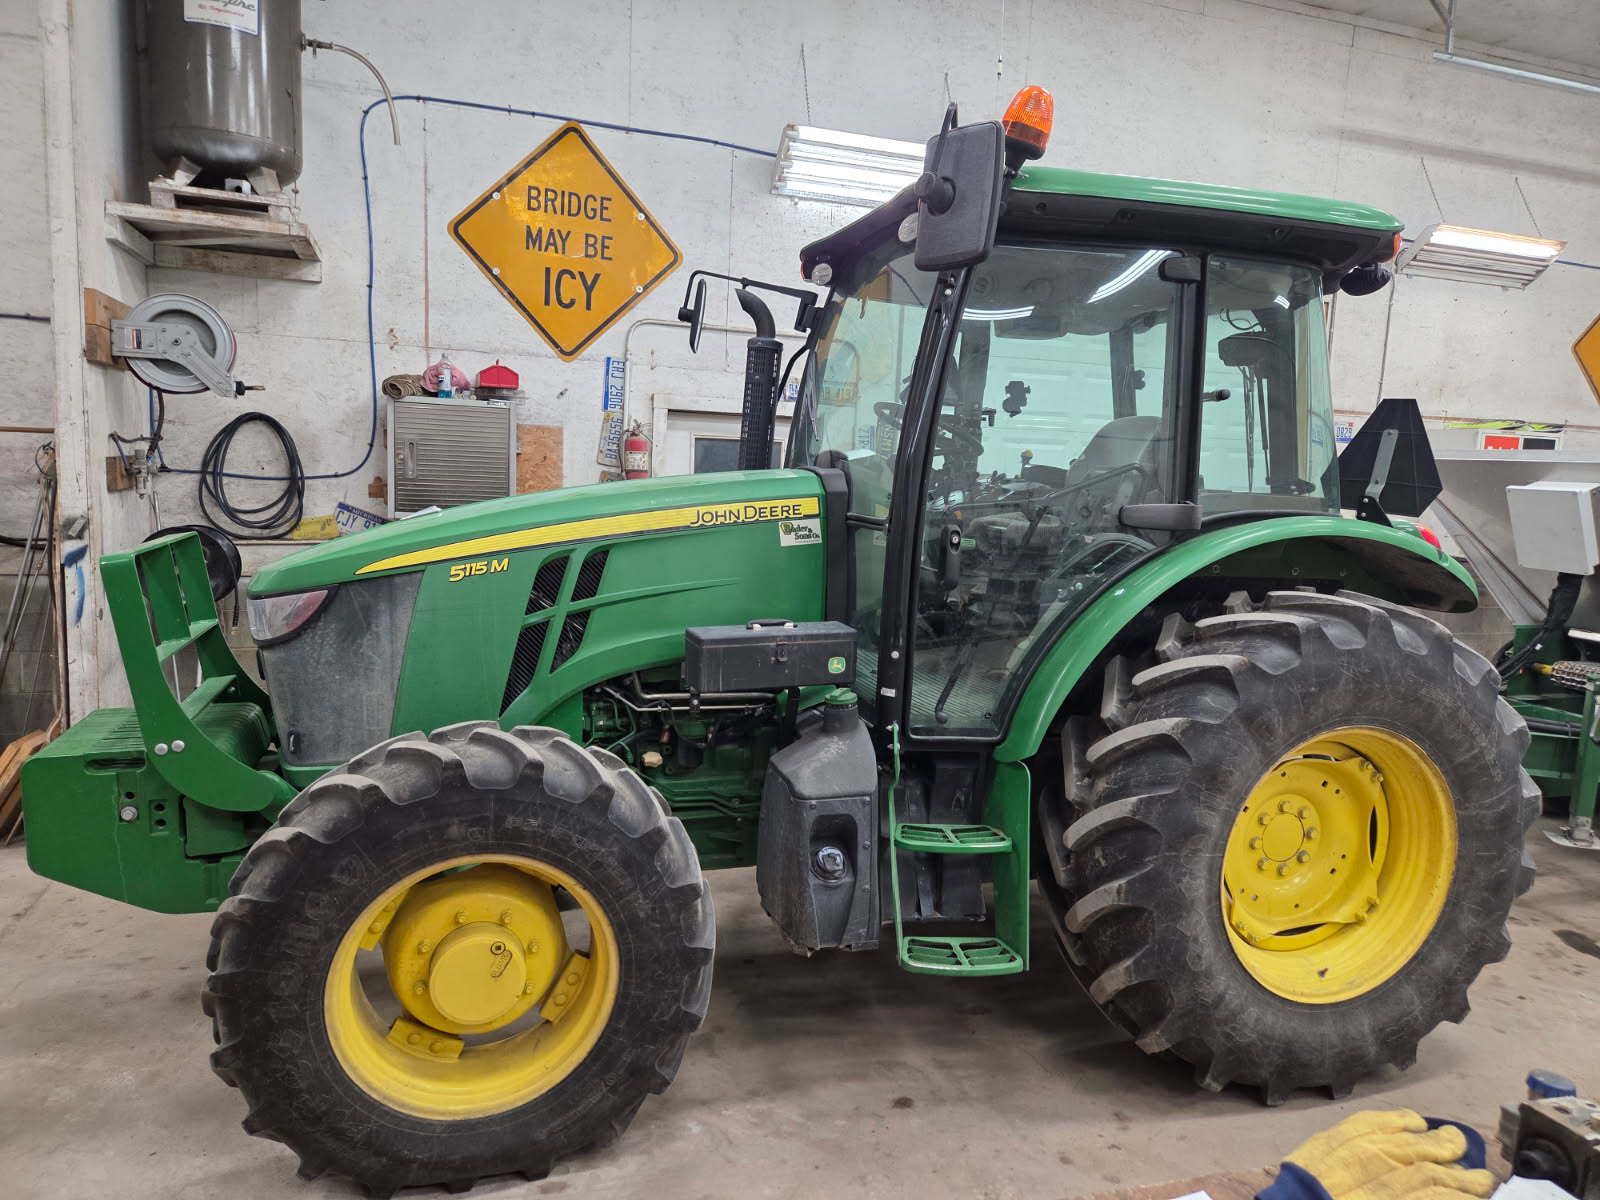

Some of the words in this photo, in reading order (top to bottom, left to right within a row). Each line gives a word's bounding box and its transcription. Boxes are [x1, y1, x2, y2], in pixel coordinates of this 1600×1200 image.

[527, 185, 612, 222] BRIDGE
[525, 224, 571, 256] MAY
[584, 233, 613, 261] BE
[544, 267, 601, 311] ICY
[690, 508, 740, 525] JOHN
[743, 504, 802, 520] DEERE
[448, 560, 488, 583] 5115
[490, 557, 510, 573] M
